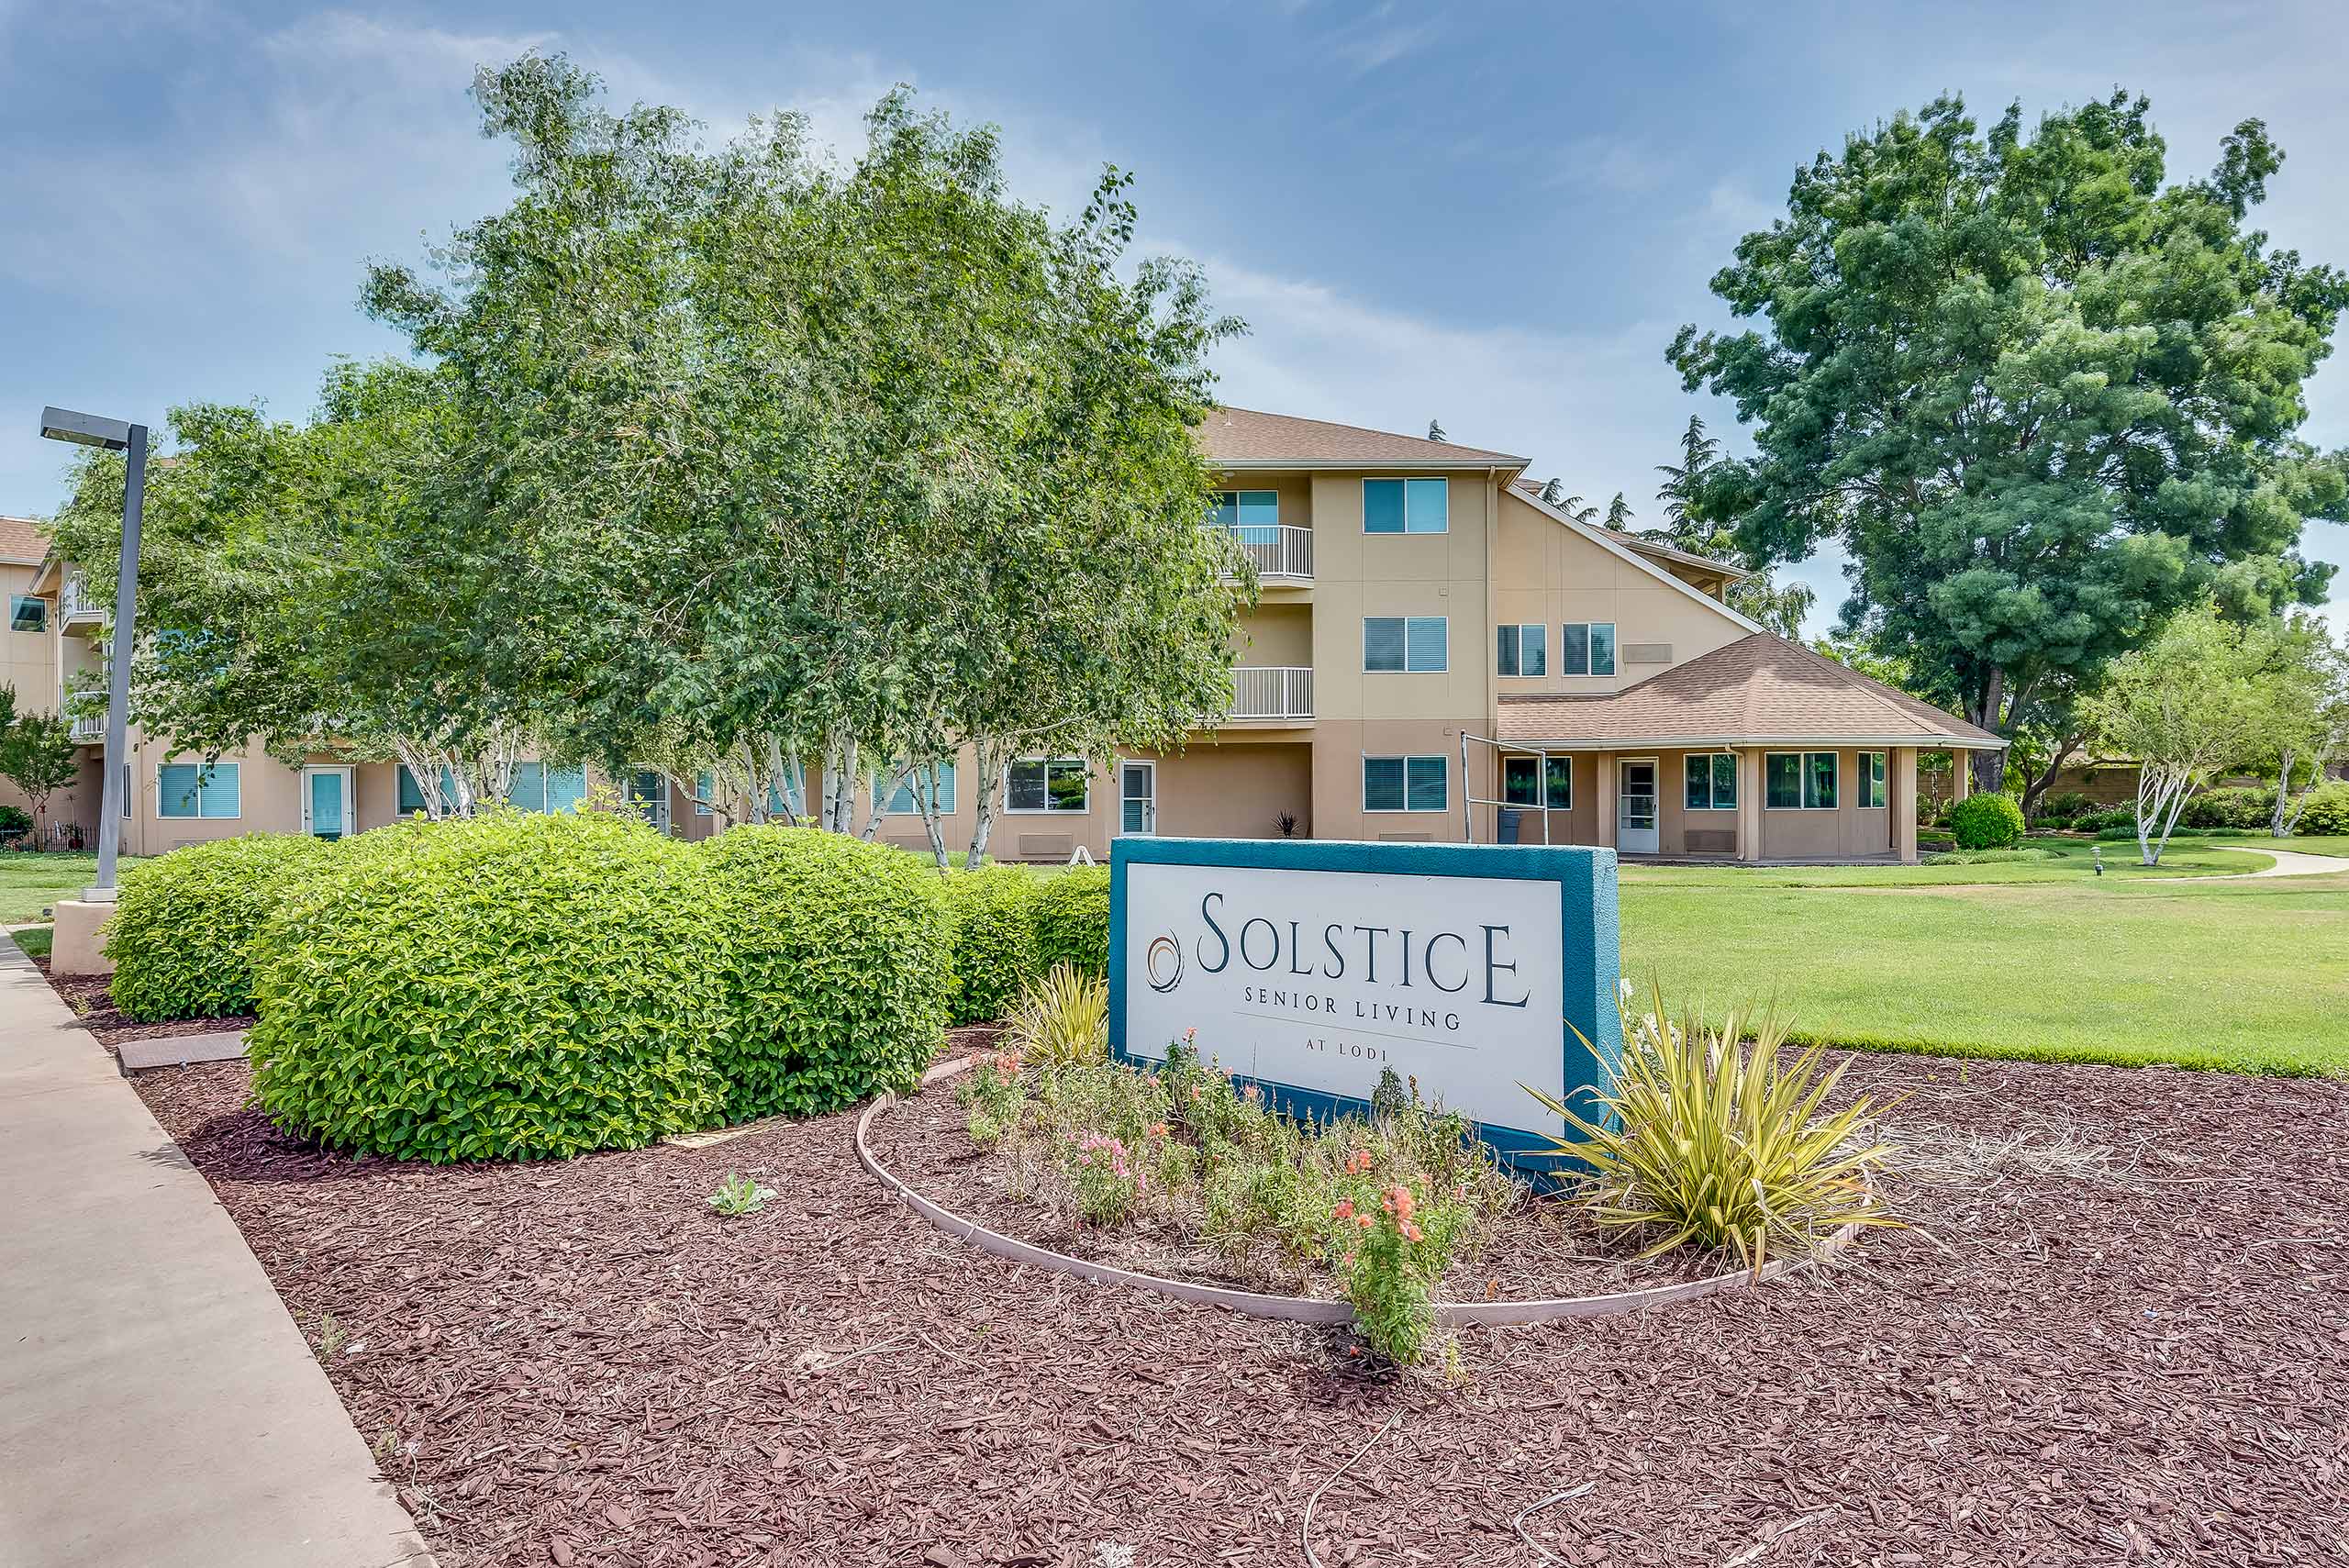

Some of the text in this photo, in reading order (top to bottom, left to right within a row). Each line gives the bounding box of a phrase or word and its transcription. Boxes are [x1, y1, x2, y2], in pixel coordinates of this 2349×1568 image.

[1197, 892, 1531, 1007] SOLSTICE
[1245, 986, 1461, 1030] SENIOR LIVING
[1306, 1039, 1387, 1062] AT LODI
